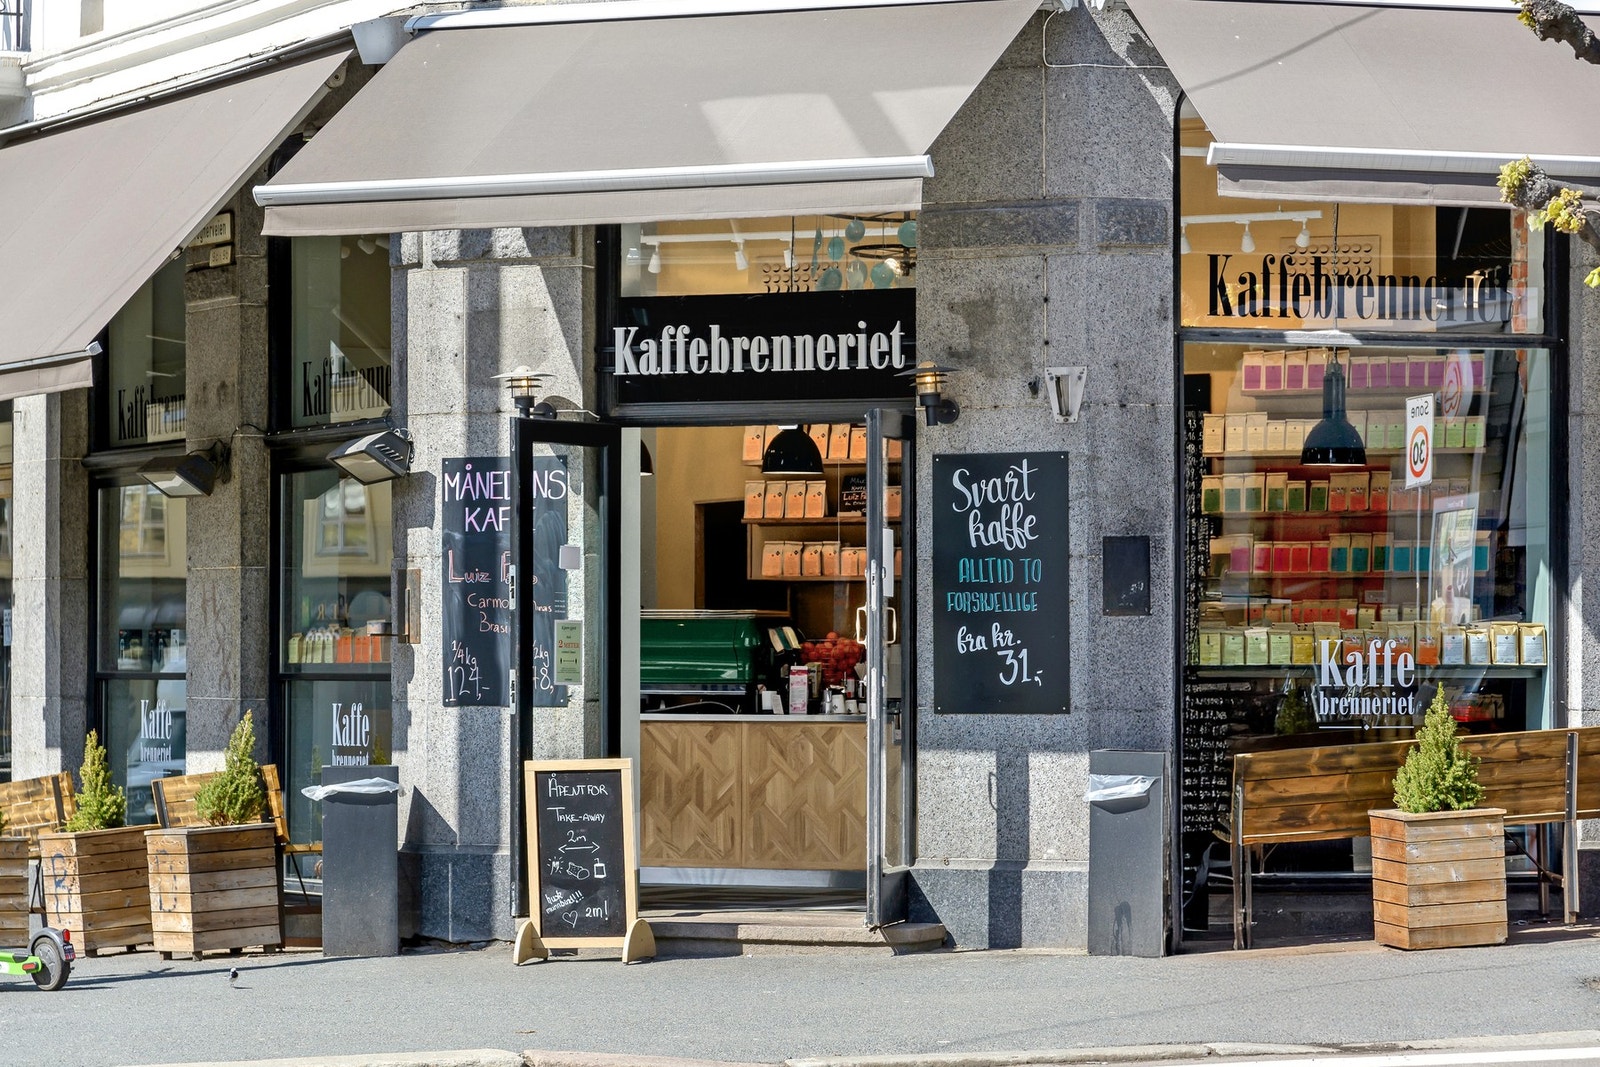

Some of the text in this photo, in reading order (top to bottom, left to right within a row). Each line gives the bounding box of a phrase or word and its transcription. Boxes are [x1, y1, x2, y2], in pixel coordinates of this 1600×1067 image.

[613, 320, 906, 376] Kaffebrenneriet
[952, 458, 1039, 512] Svart
[969, 502, 1039, 551] kaffe
[958, 557, 1042, 584] ALLTID TO
[947, 591, 1038, 614] FORSKJELLIGE
[957, 622, 1021, 654] fra kr.
[1319, 639, 1415, 688] Kaffe
[140, 699, 172, 739] Kaffe
[1319, 691, 1415, 715] brenneriet
[331, 702, 370, 747] Kaffe
[548, 772, 609, 798] ÅPENT FOR
[566, 829, 587, 842] 2m
[585, 900, 609, 921] 2m!
